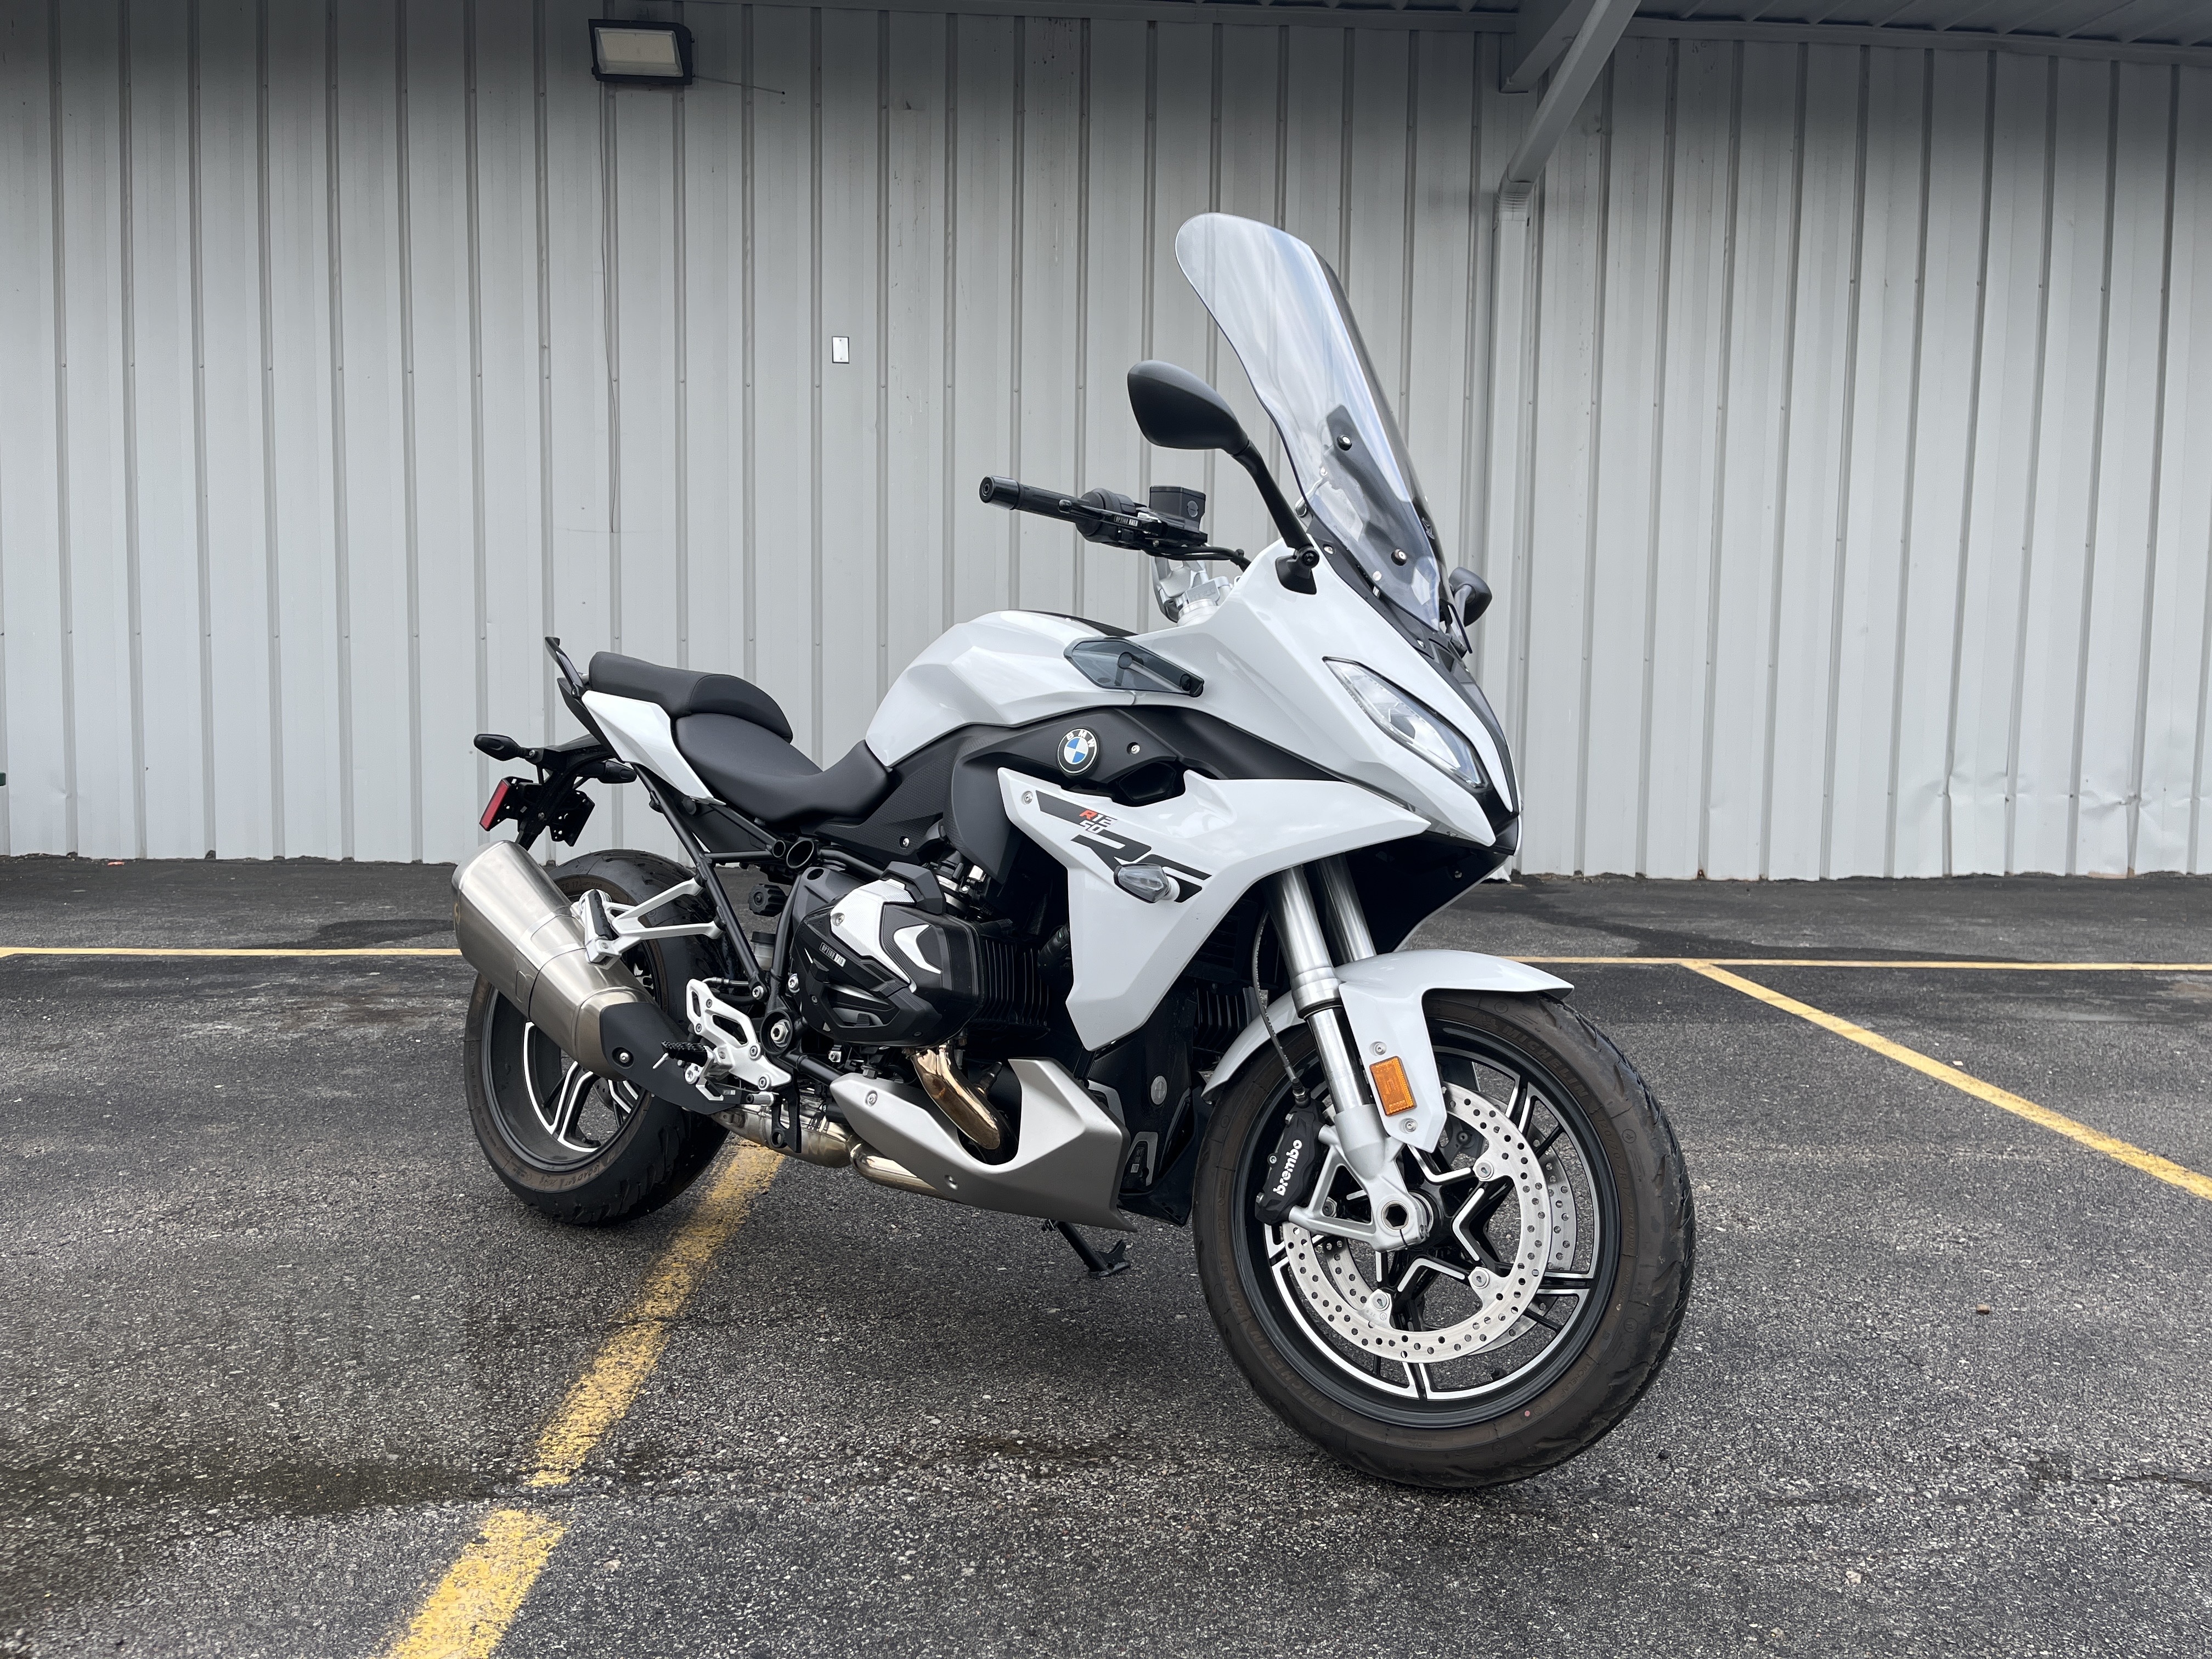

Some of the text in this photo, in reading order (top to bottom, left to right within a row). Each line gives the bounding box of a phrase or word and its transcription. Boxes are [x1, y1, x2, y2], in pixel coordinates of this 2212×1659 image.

[1066, 730, 1096, 748] BMW
[1502, 1025, 1589, 1097] MICHELIN
[1273, 1139, 1302, 1196] brembo
[1250, 1330, 1327, 1408] MICHELIN
